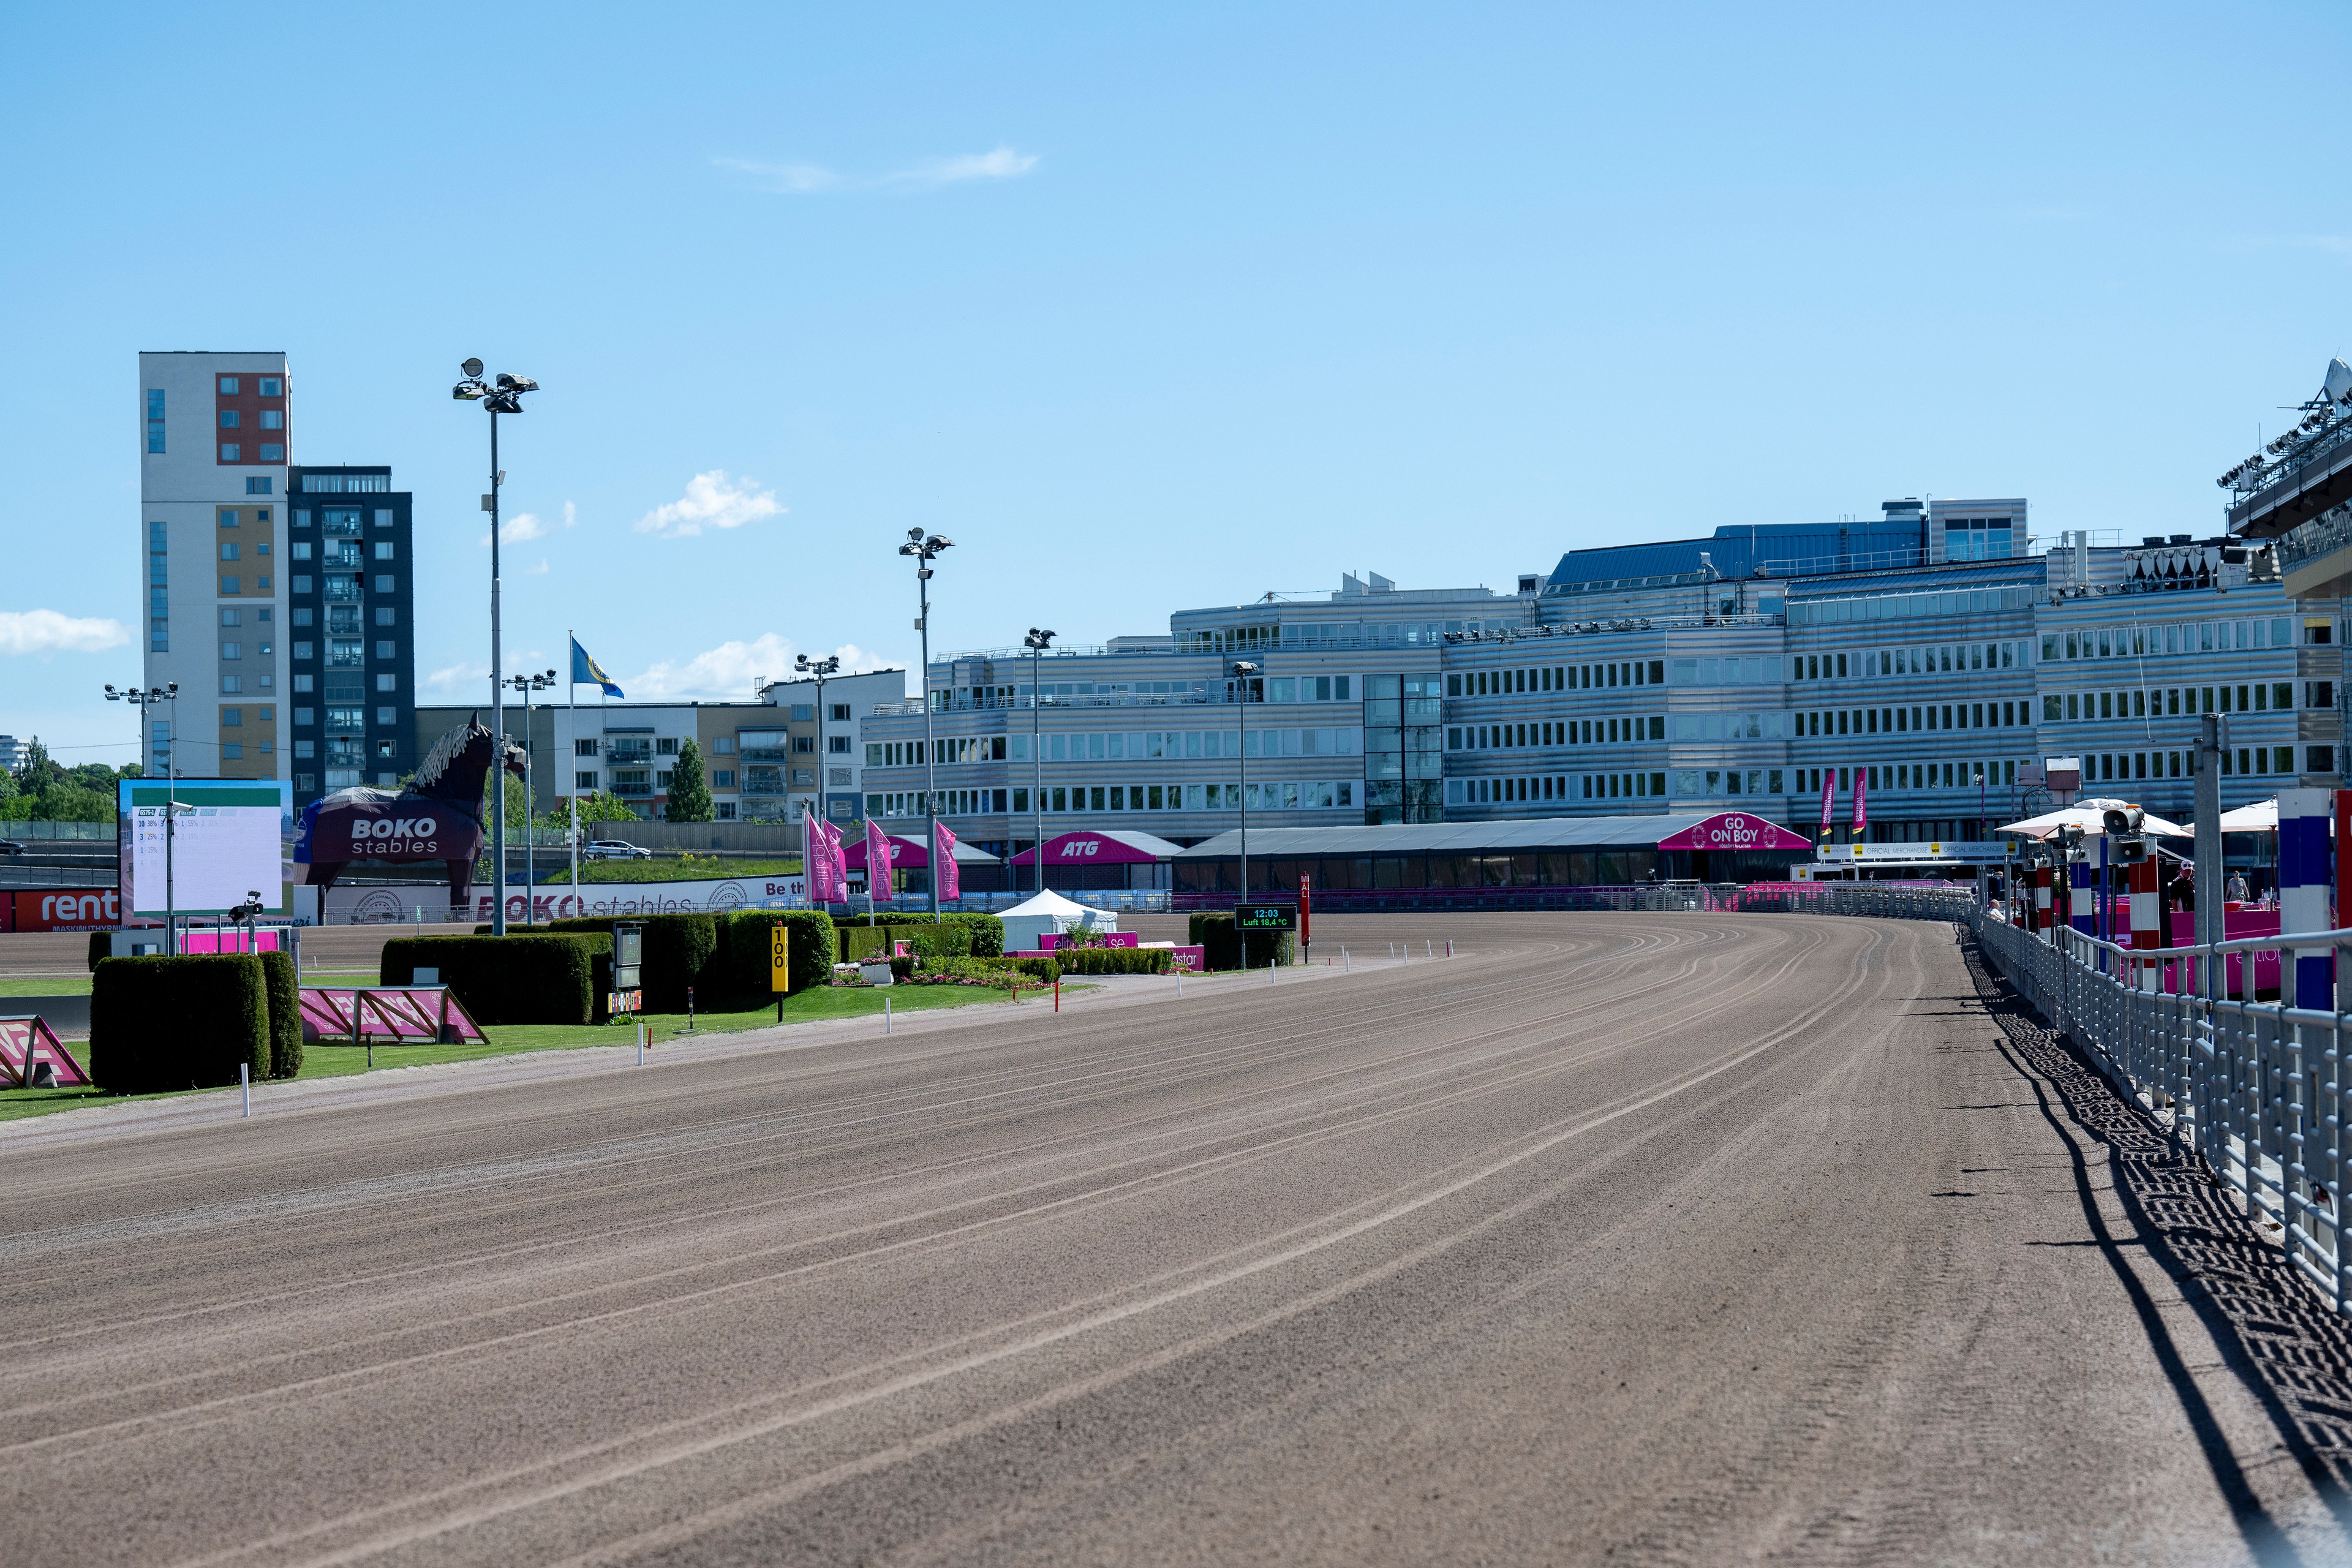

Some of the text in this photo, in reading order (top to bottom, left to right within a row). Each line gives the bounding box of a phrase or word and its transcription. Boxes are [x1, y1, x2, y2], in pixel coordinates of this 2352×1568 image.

[352, 818, 437, 839] BOKO
[1725, 817, 1744, 829] GO
[1711, 829, 1731, 842] ON
[1733, 829, 1758, 842] BOY
[352, 839, 438, 854] stables
[1061, 841, 1099, 856] ATG
[766, 881, 804, 895] Be th
[774, 930, 783, 968] 100
[1171, 952, 1197, 965] ästar
